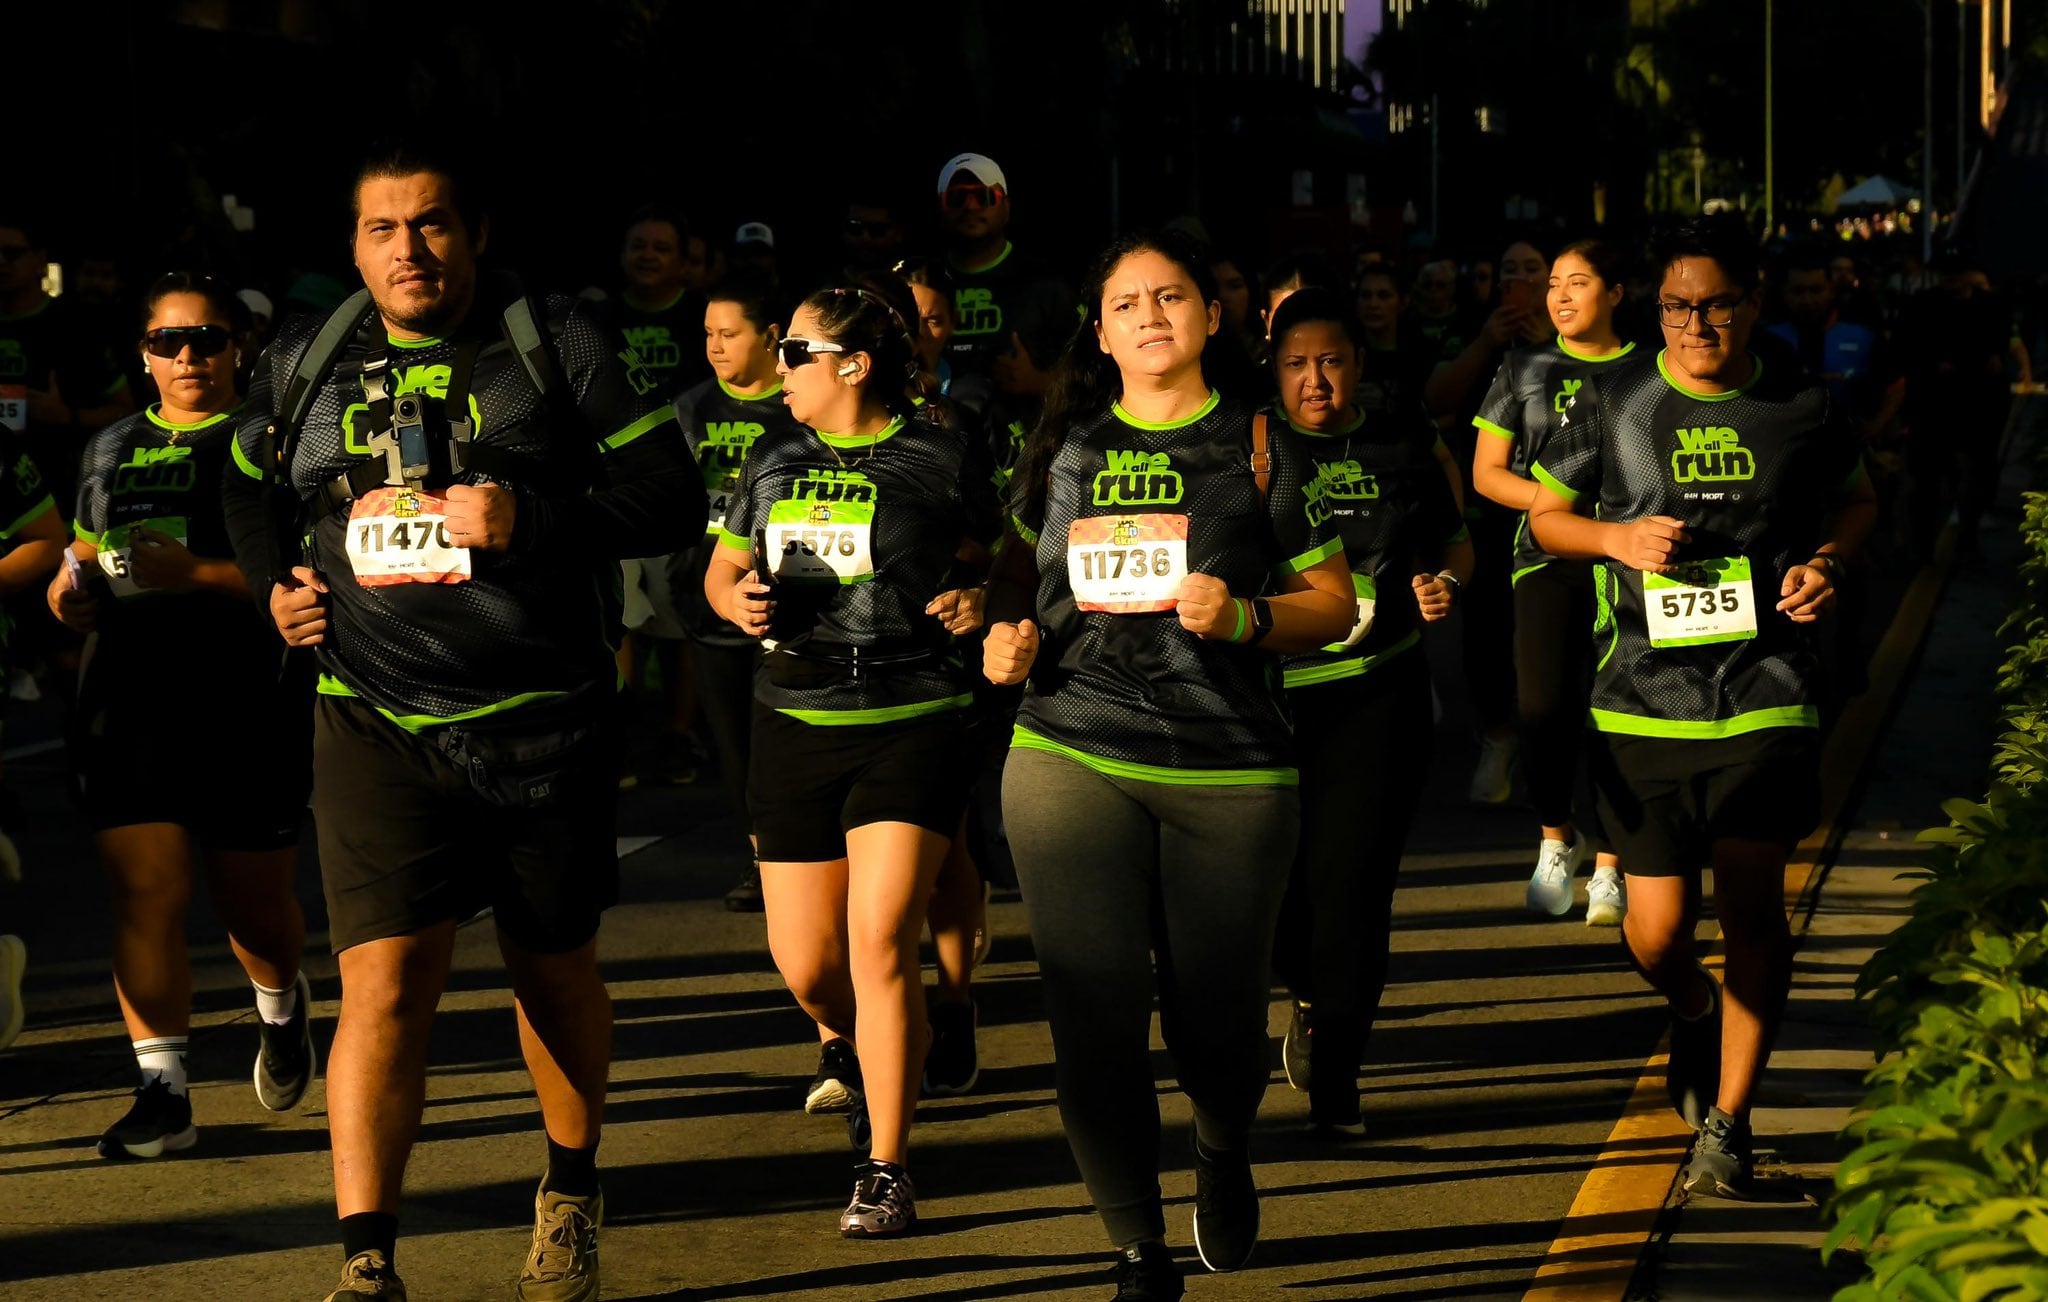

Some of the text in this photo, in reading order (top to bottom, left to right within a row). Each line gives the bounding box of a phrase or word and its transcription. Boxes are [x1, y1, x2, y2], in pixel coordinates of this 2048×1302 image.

[1704, 441, 1720, 450] all
[1676, 451, 1751, 479] run
[1098, 474, 1178, 502] run
[781, 530, 855, 556] 5576
[1080, 548, 1171, 580] 11736
[1662, 589, 1739, 618] 5735
[530, 783, 551, 798] CAT
